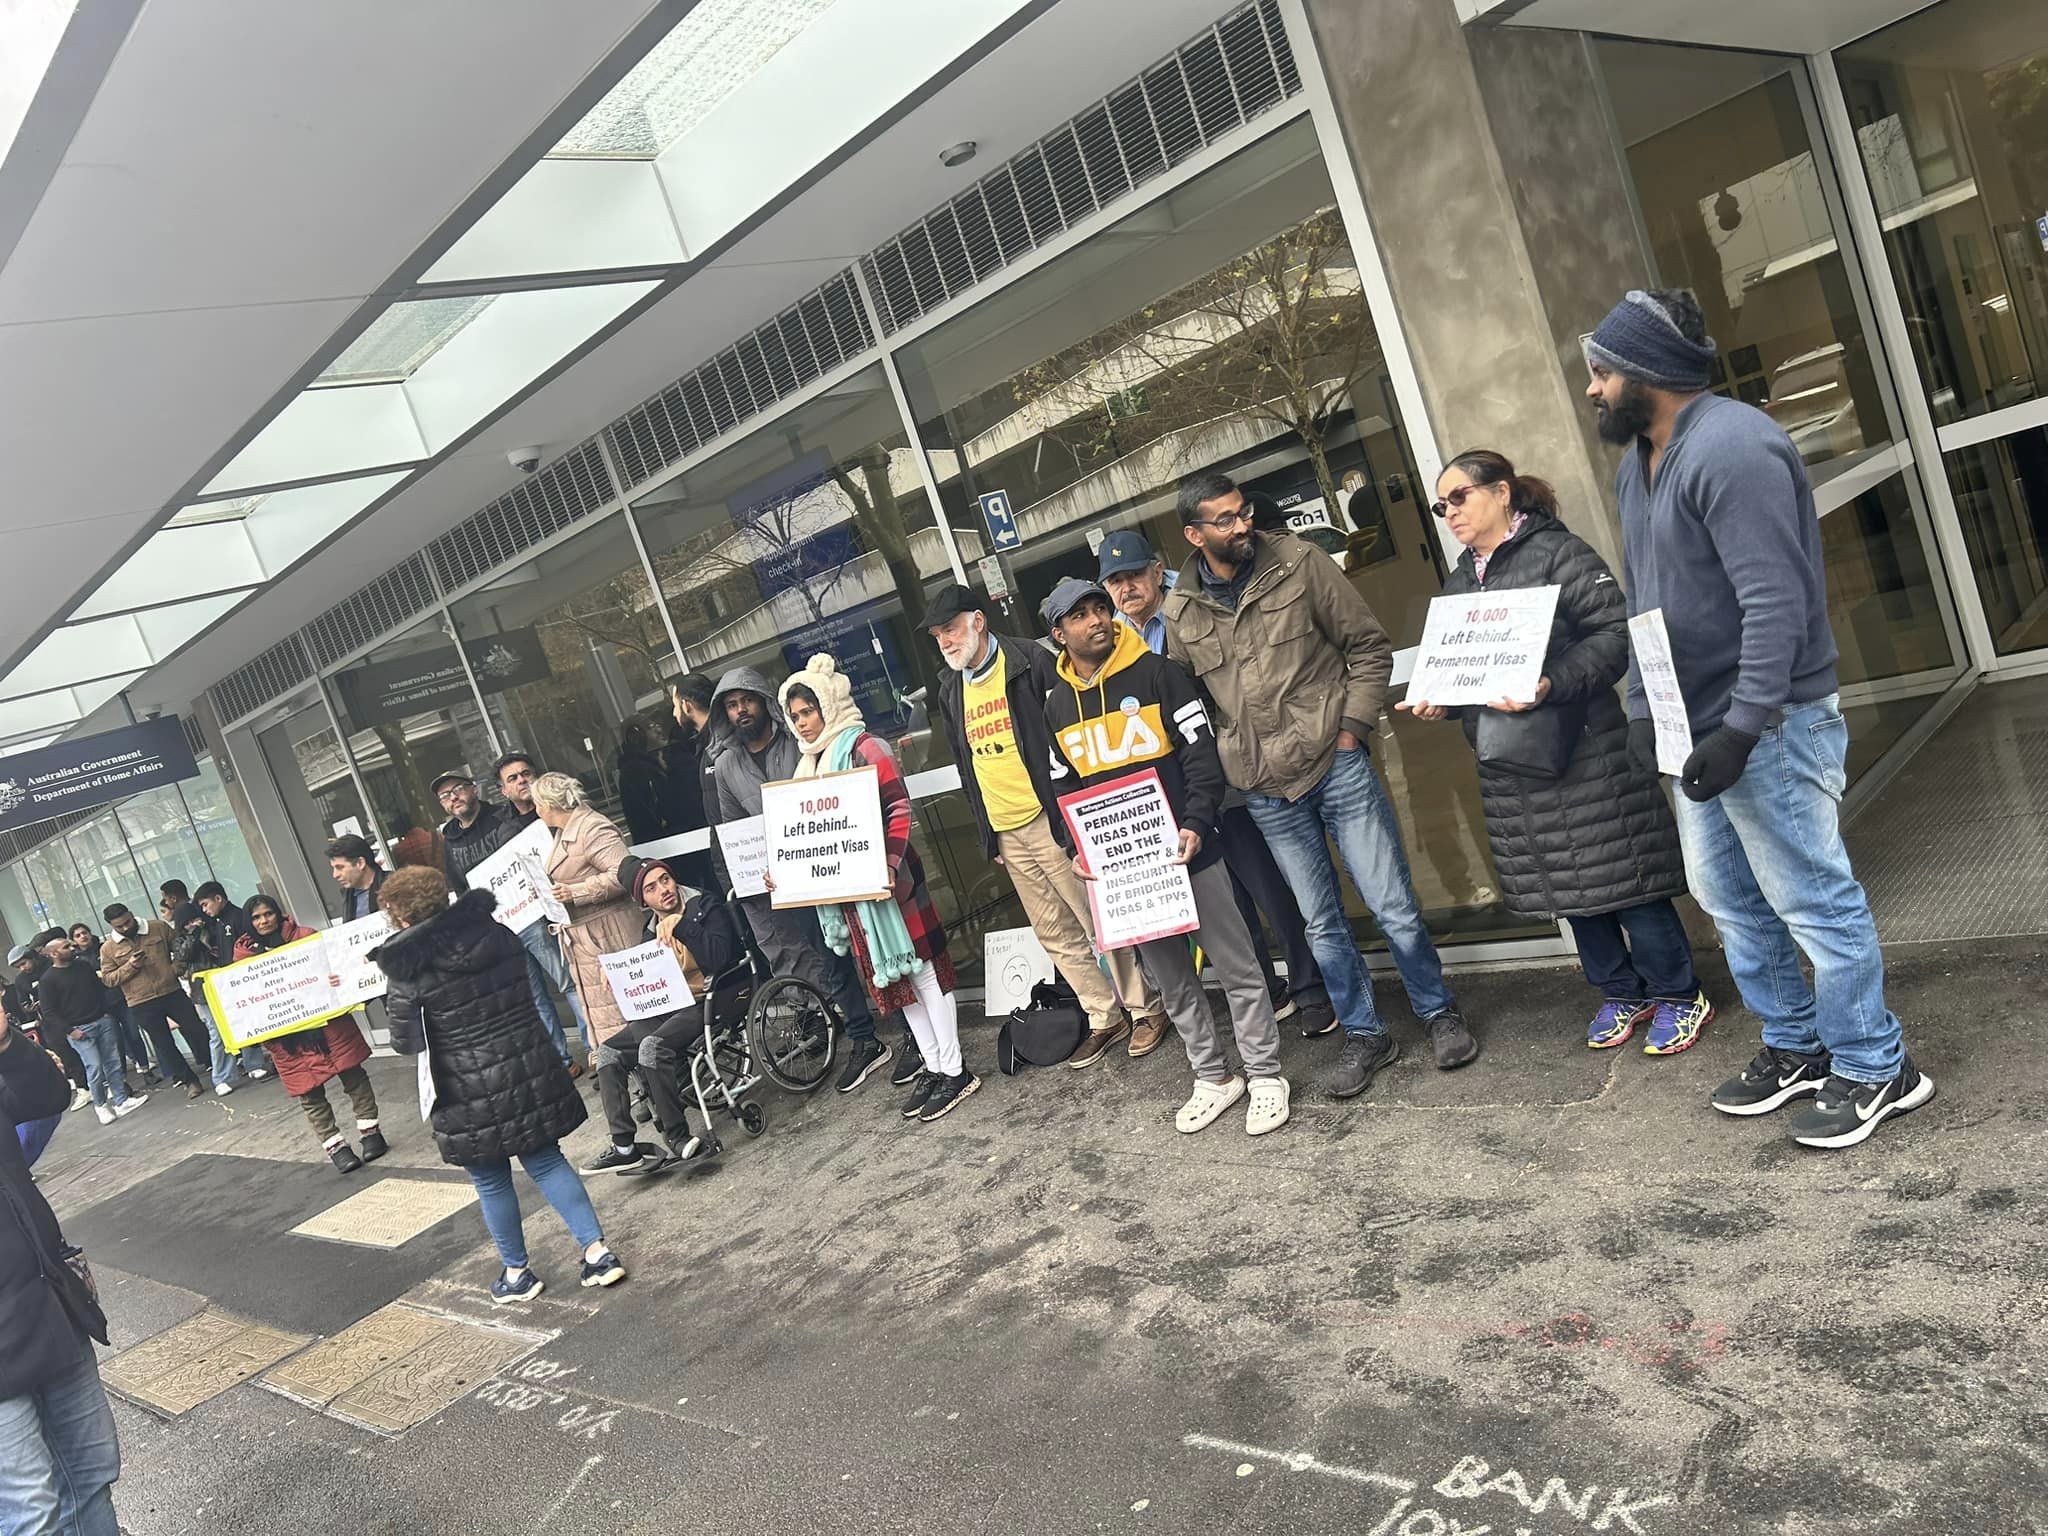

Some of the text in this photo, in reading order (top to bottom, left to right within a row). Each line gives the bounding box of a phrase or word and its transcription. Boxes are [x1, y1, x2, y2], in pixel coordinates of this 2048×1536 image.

[768, 558, 803, 578] check-in
[1464, 608, 1509, 624] 10,000
[1441, 629, 1520, 646] Left Behind...
[1425, 652, 1527, 669] Permanent Visas
[1452, 672, 1486, 688] Now!
[965, 697, 1007, 722] ELCOM
[966, 718, 1012, 744] EFUGEE
[1064, 716, 1160, 768] FILA
[28, 749, 142, 786] Australian Government
[32, 761, 164, 803] Department of Home Affairs
[800, 796, 839, 816] 10,000
[1084, 800, 1162, 832] PERMANENT
[784, 816, 857, 838] Left Behind...
[1091, 816, 1166, 846] VISAS NOW!
[778, 846, 838, 862] Permanent
[842, 839, 870, 854] Visas
[1105, 834, 1162, 858] END THE
[811, 862, 840, 878] Now!
[1102, 847, 1176, 876] POVERTY &
[1106, 864, 1176, 890] INSECURITY
[1106, 876, 1183, 904] OF BRIDGING
[1107, 890, 1188, 919] VISAS & TPVs
[348, 928, 390, 946] 12 Years
[247, 956, 288, 973] Australia,
[630, 957, 640, 966] No
[641, 948, 664, 962] Future
[230, 955, 310, 988] Be Our Safe Haven!
[264, 976, 285, 989] After
[629, 969, 644, 980] End
[235, 974, 319, 1010] 12 Years In Limbo
[358, 976, 378, 990] End
[624, 978, 668, 998] FastTrack
[267, 1004, 305, 1022] Grant Us
[268, 997, 296, 1011] Please
[634, 995, 670, 1012] Injustice!
[246, 1003, 330, 1038] A Permanent Home!
[1434, 1455, 1677, 1535] BANK
